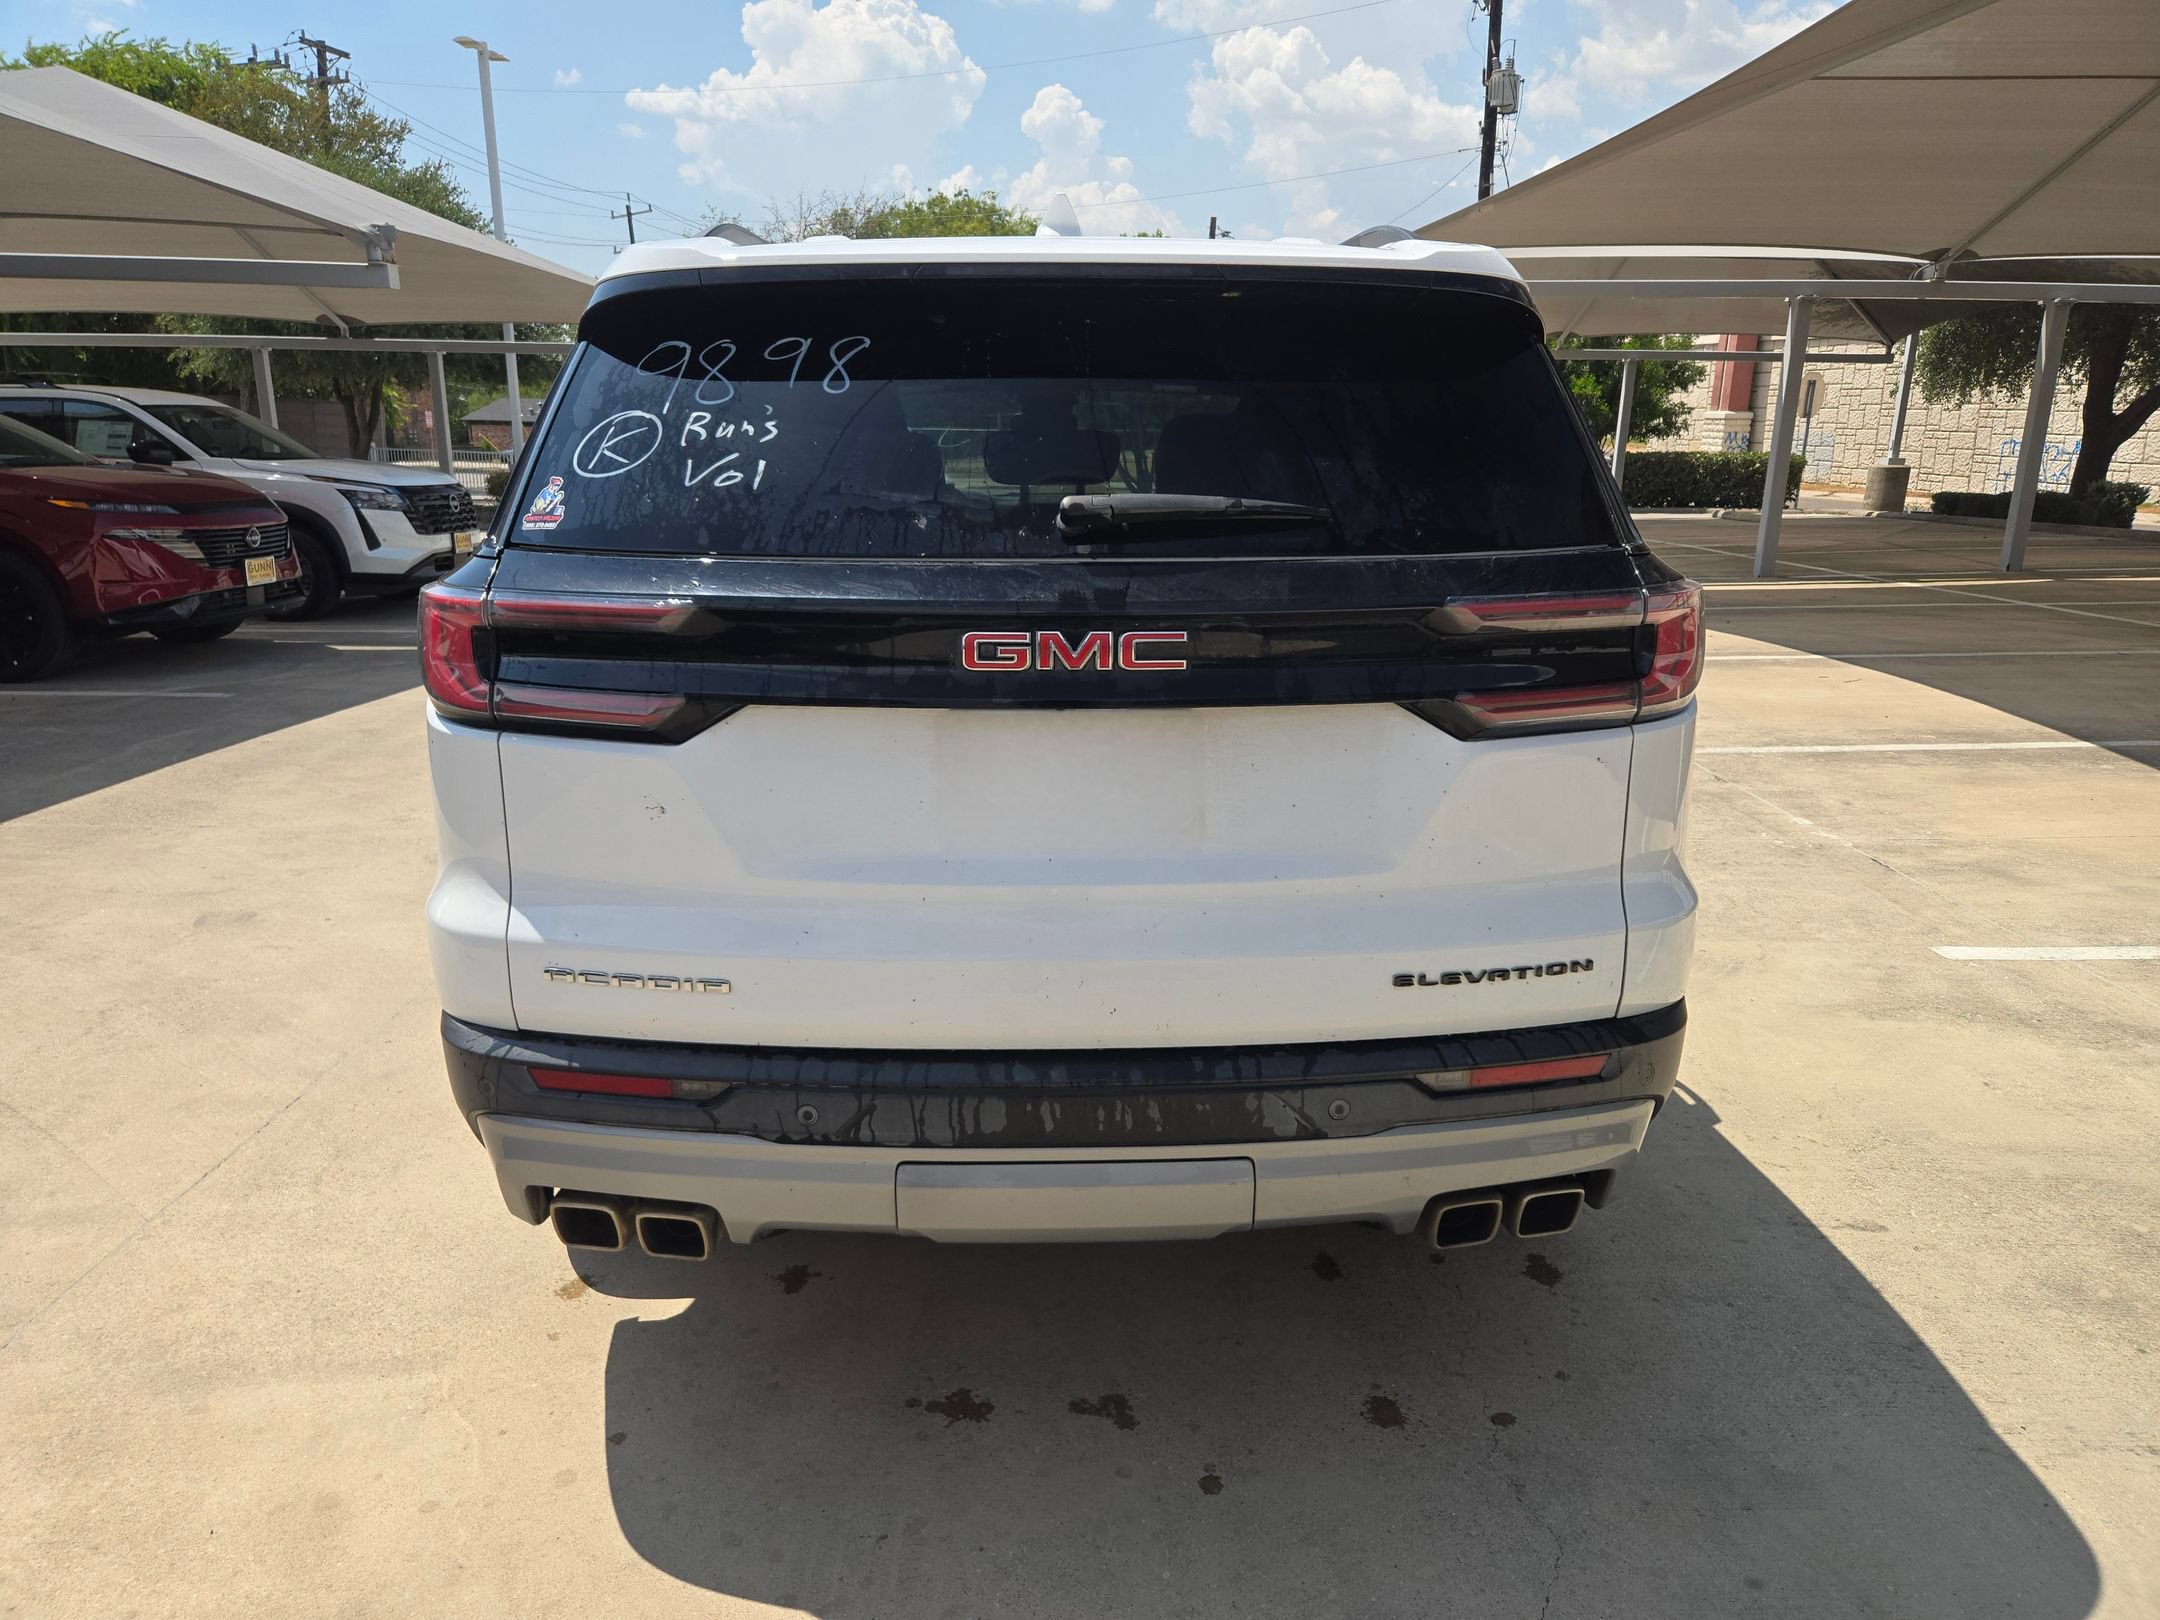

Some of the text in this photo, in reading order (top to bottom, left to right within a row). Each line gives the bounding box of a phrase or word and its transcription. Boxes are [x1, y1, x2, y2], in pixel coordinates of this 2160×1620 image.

[247, 560, 272, 573] GUNN
[962, 631, 1187, 670] GMC
[543, 966, 731, 993] ACADIA
[1391, 958, 1594, 987] ELEVATION
